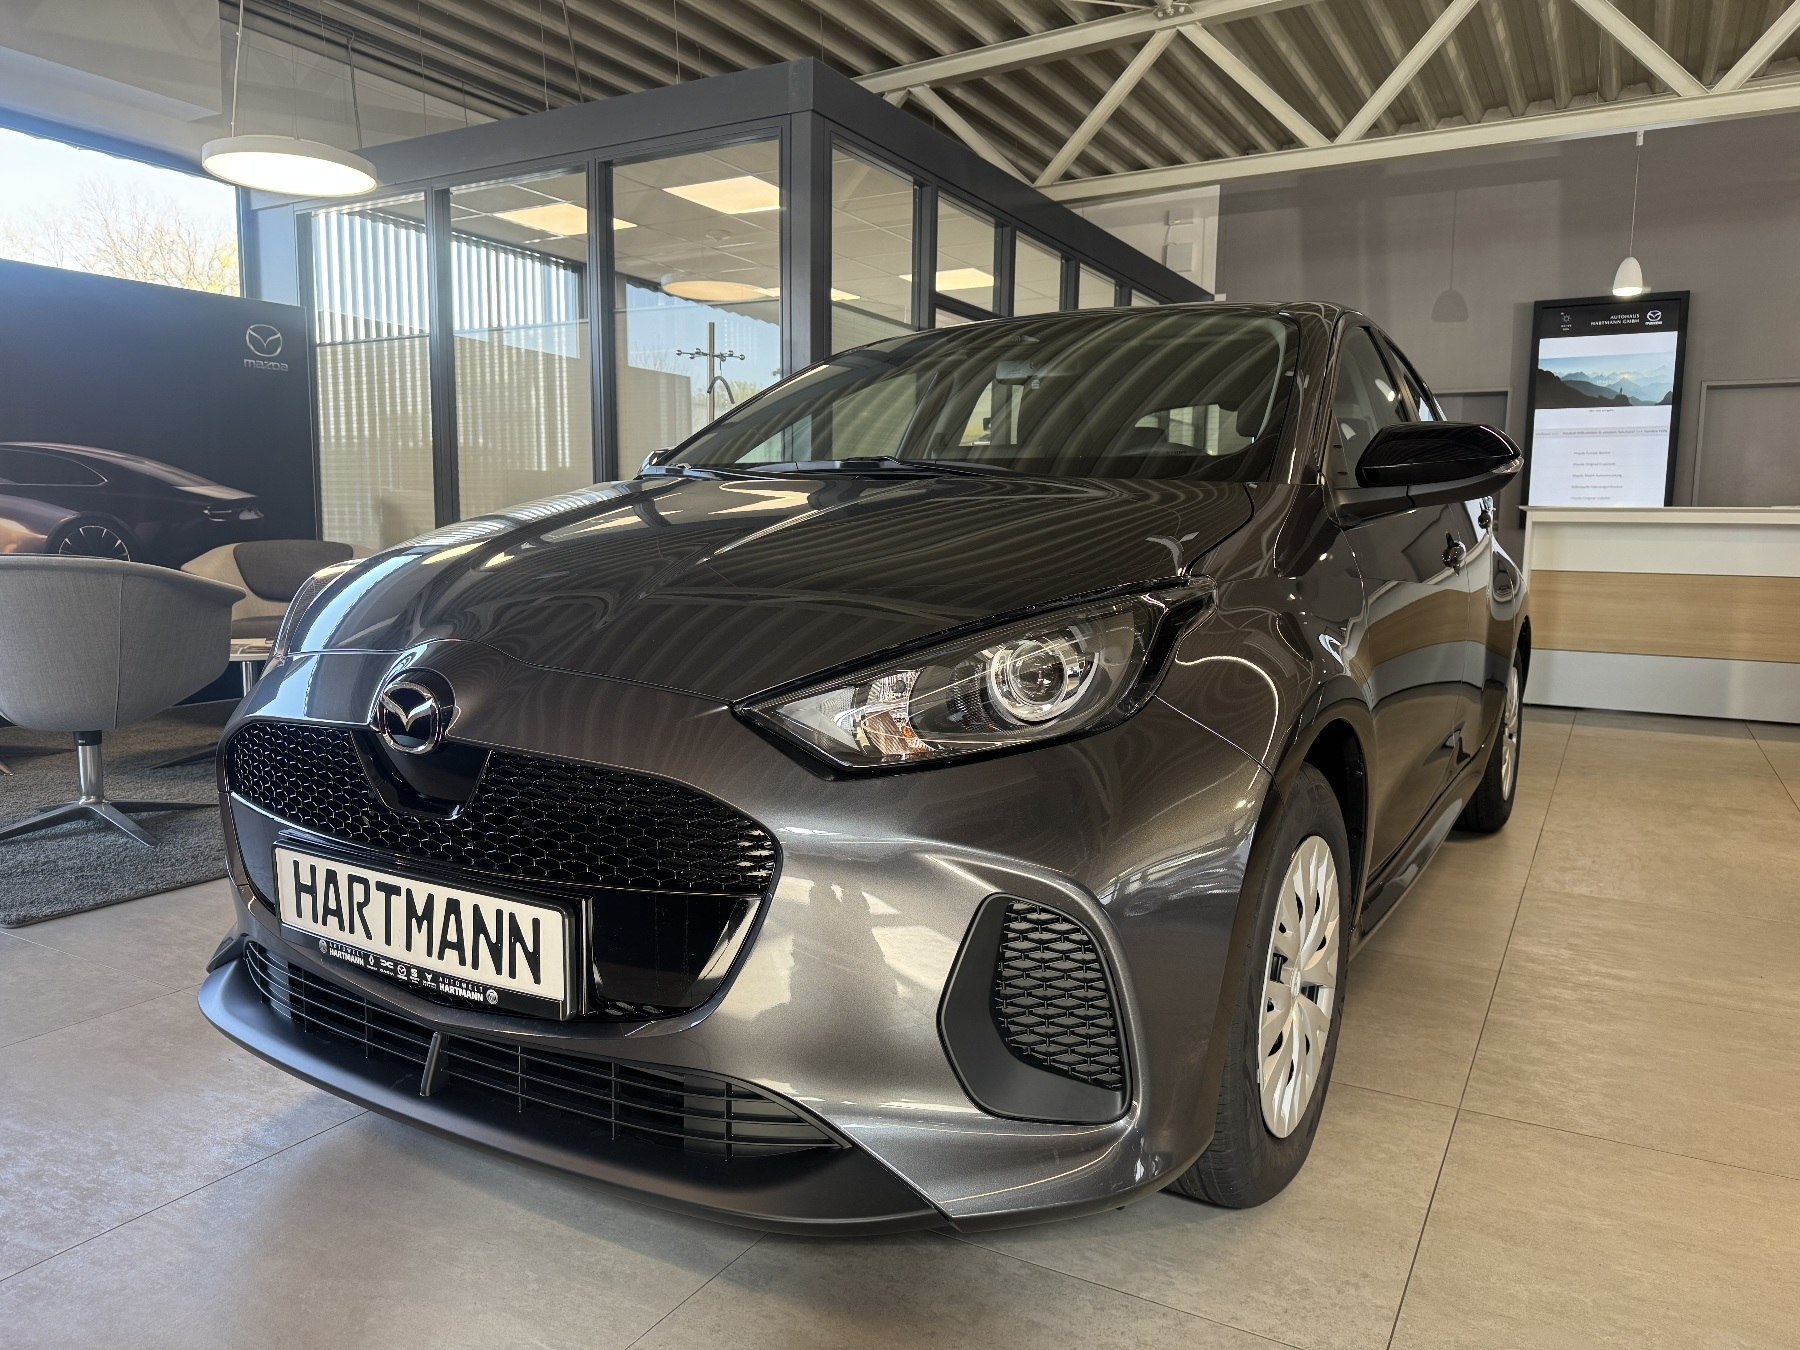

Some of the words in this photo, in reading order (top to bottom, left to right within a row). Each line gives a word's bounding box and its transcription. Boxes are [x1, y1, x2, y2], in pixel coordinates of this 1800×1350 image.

[243, 358, 289, 372] mazda
[293, 859, 541, 986] HARTMANN
[329, 948, 365, 966] HARTMANN
[439, 976, 483, 993] AUTOWELT
[439, 983, 484, 1002] HARTMANN
